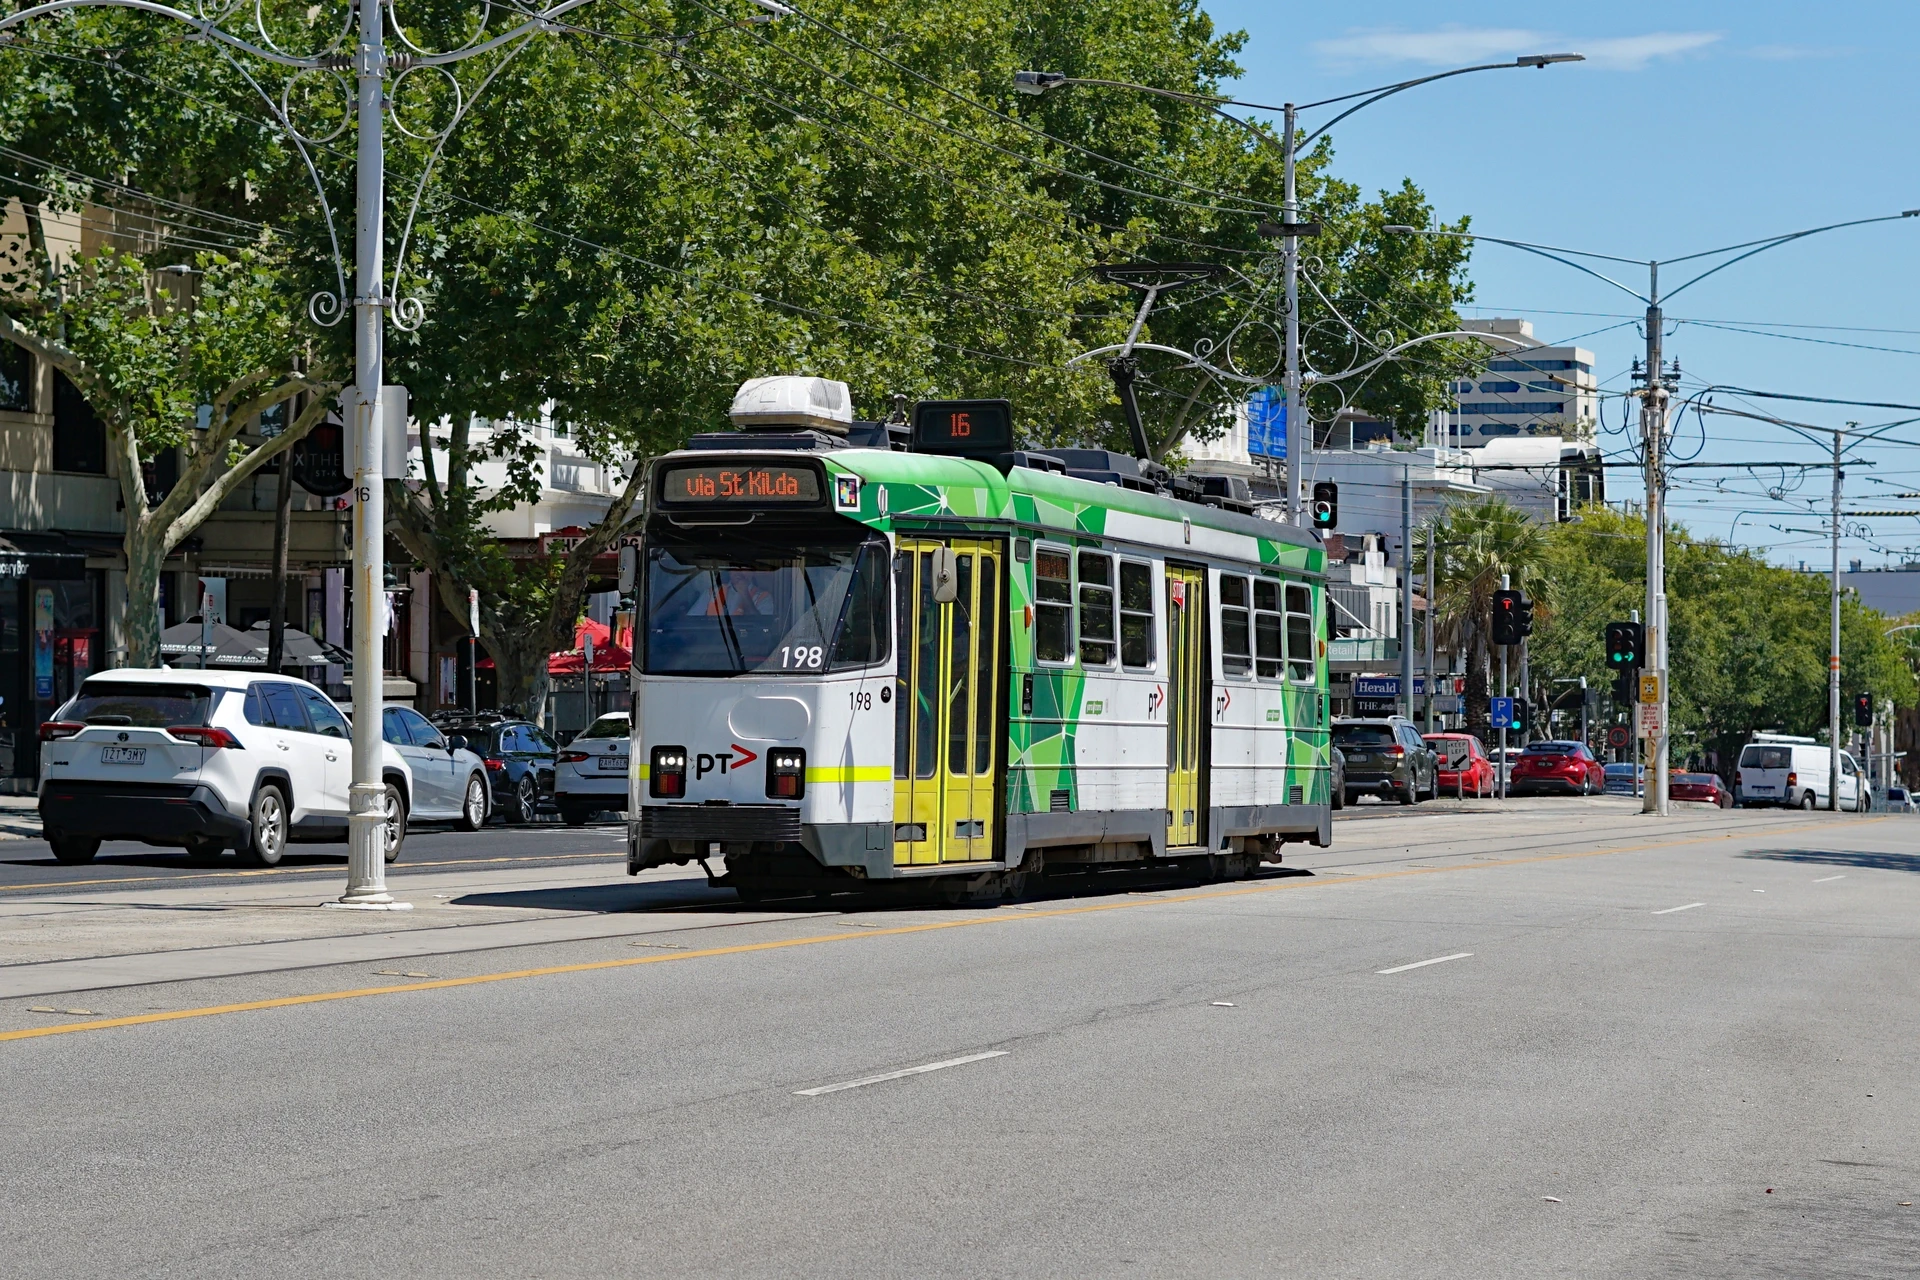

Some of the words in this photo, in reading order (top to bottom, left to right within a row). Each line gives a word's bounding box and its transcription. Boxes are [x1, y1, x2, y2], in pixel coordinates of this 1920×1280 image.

[949, 413, 971, 437] 16
[686, 476, 715, 497] via
[719, 471, 743, 497] St
[748, 472, 799, 496] Kilda
[354, 487, 370, 503] 16
[16, 559, 30, 575] Bar
[781, 645, 824, 669] 198
[1358, 681, 1397, 693] Herald
[849, 691, 872, 711] 198
[1357, 701, 1379, 710] THE
[1497, 700, 1507, 712] P
